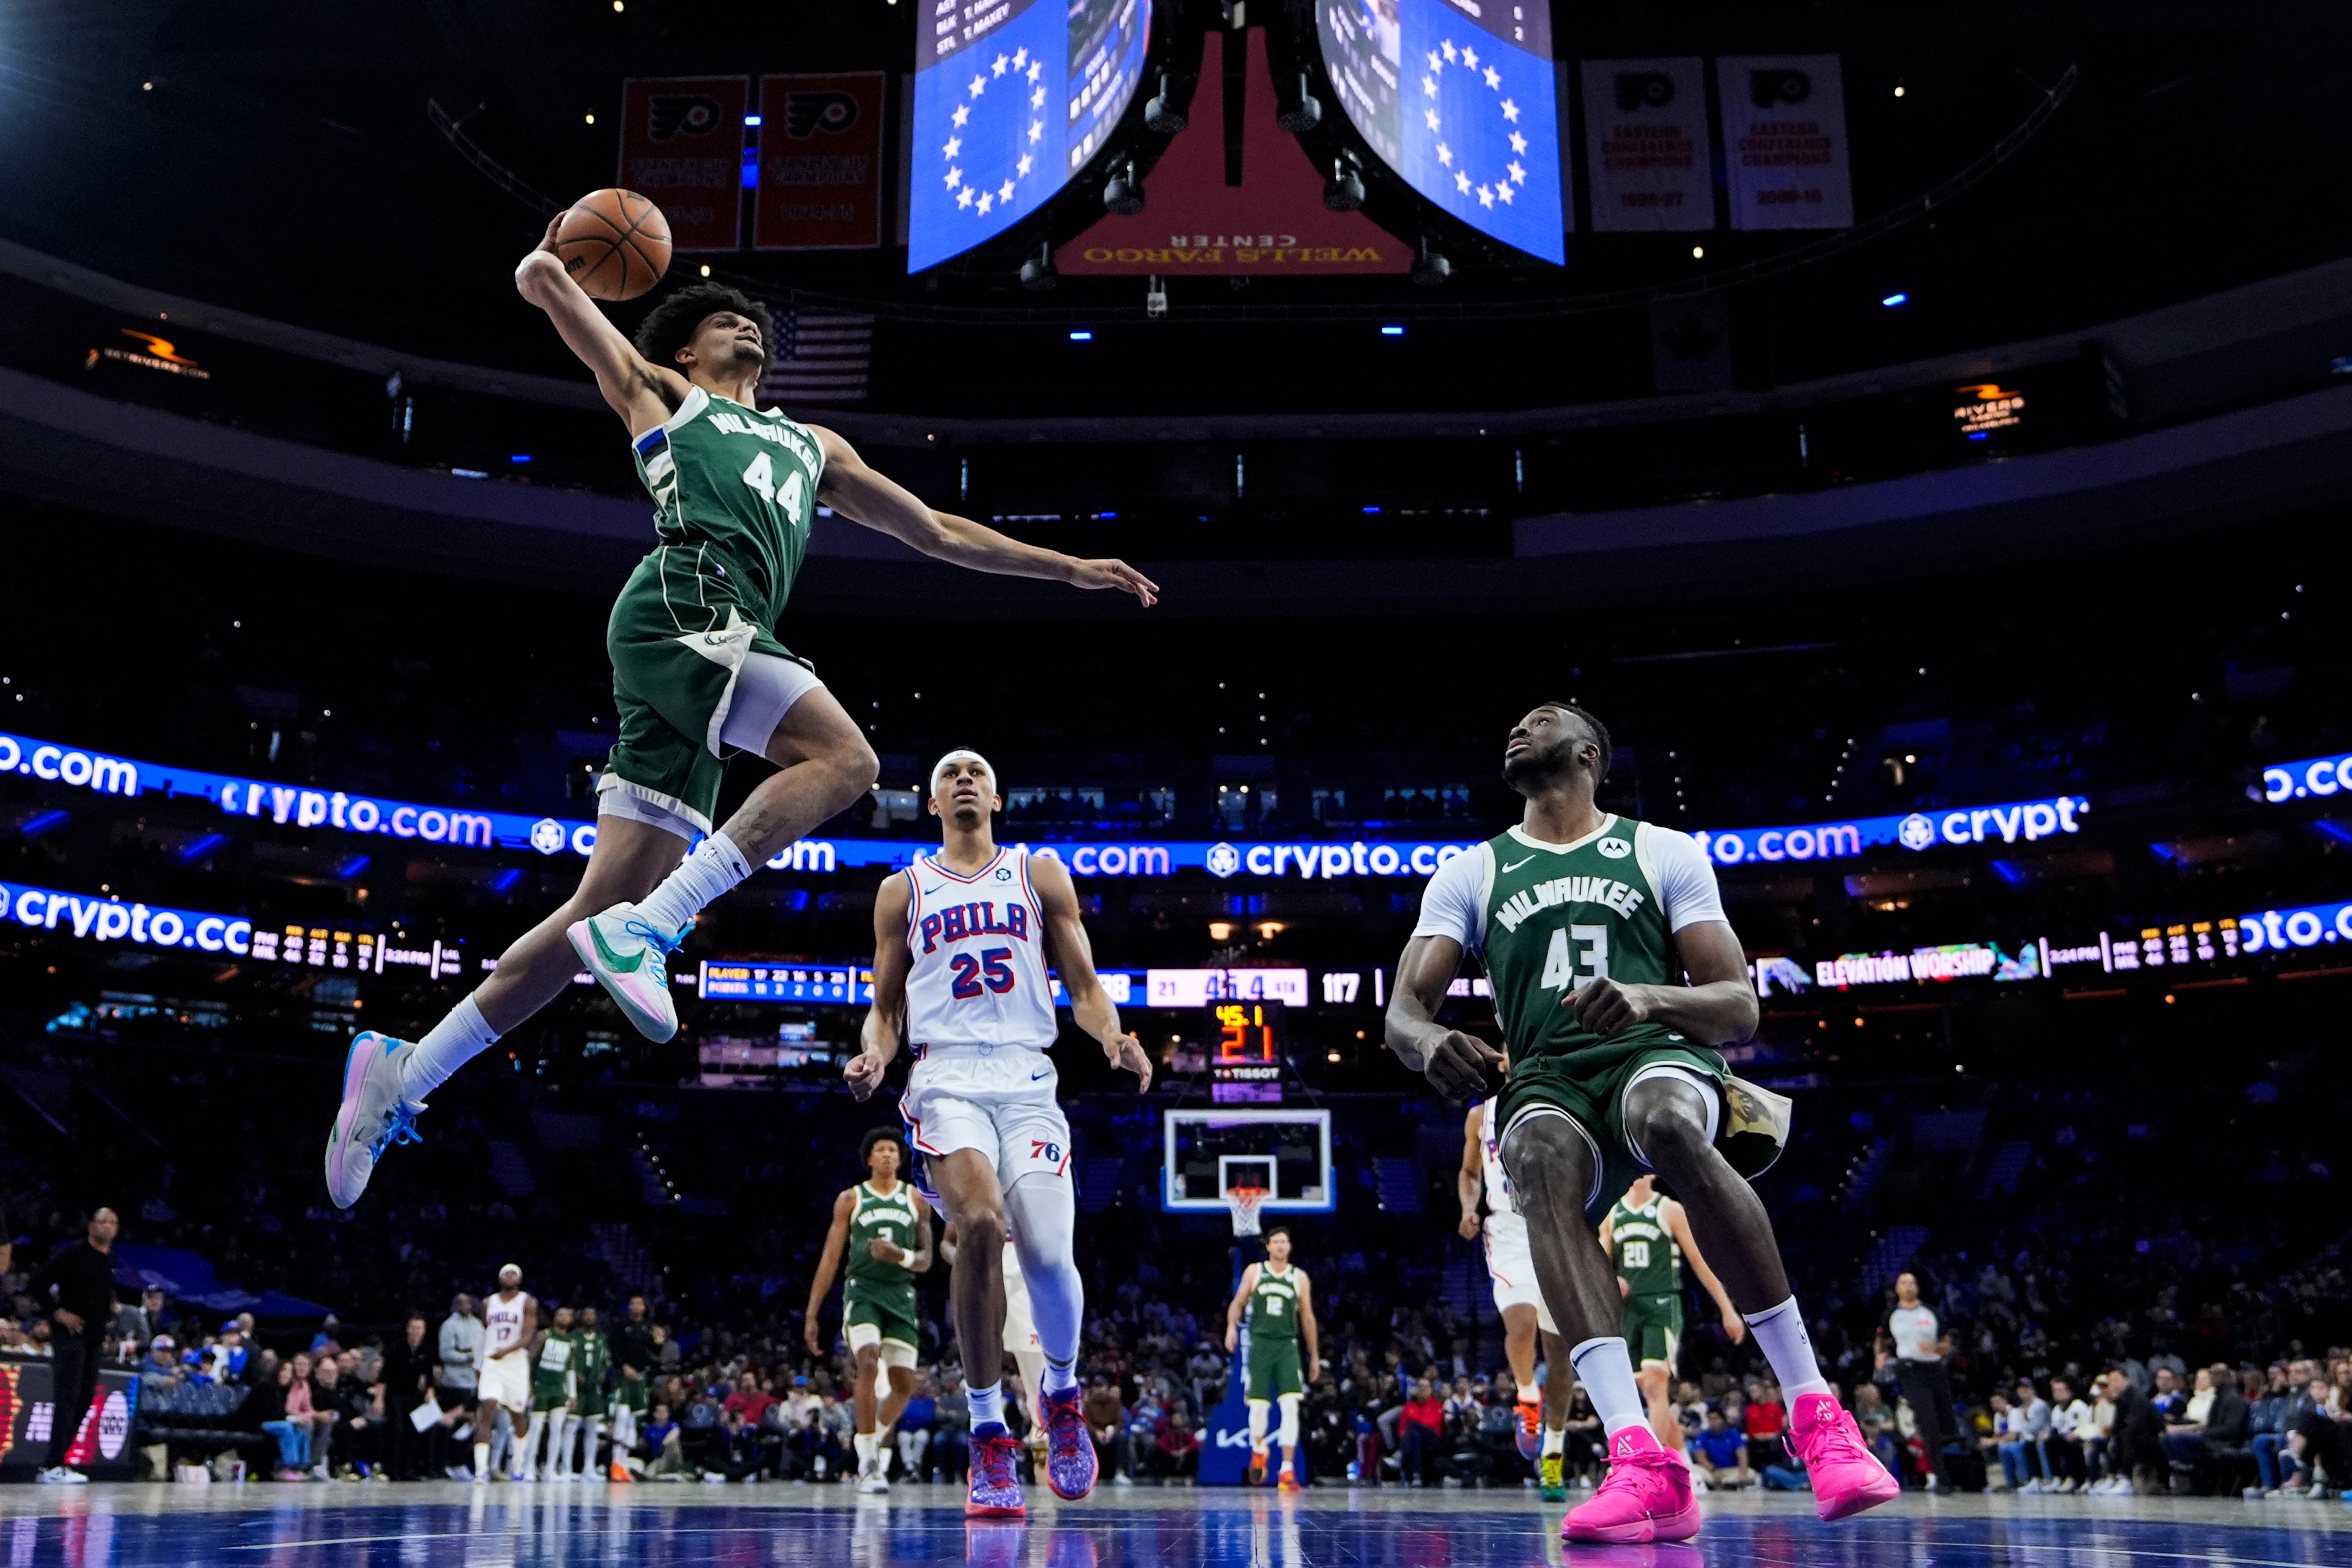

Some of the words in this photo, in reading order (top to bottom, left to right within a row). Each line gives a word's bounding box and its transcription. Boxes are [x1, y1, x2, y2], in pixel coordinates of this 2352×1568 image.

[1171, 235, 1296, 248] CENTER
[1083, 247, 1222, 263] FARGO
[1236, 248, 1382, 263] WELLS
[743, 451, 803, 526] 44
[221, 782, 493, 847] crypto.com
[1495, 876, 1645, 933] MILWAUKEE
[920, 901, 1028, 954] PHILA
[1541, 924, 1609, 992] 43
[1816, 955, 1910, 987] ELEVATION
[1909, 948, 1996, 979] WORSHIP
[709, 967, 750, 981] PLAYER
[949, 947, 1014, 999] 25
[708, 981, 749, 994] POINTS
[1158, 982, 1175, 996] 21
[1322, 973, 1361, 1003] 117
[1216, 1006, 1263, 1020] 45.1
[1221, 1020, 1273, 1062] 21
[1233, 1067, 1280, 1080] TISSOT
[1030, 1139, 1060, 1162] 76
[1623, 1242, 1650, 1268] 20
[496, 1327, 511, 1342] 17
